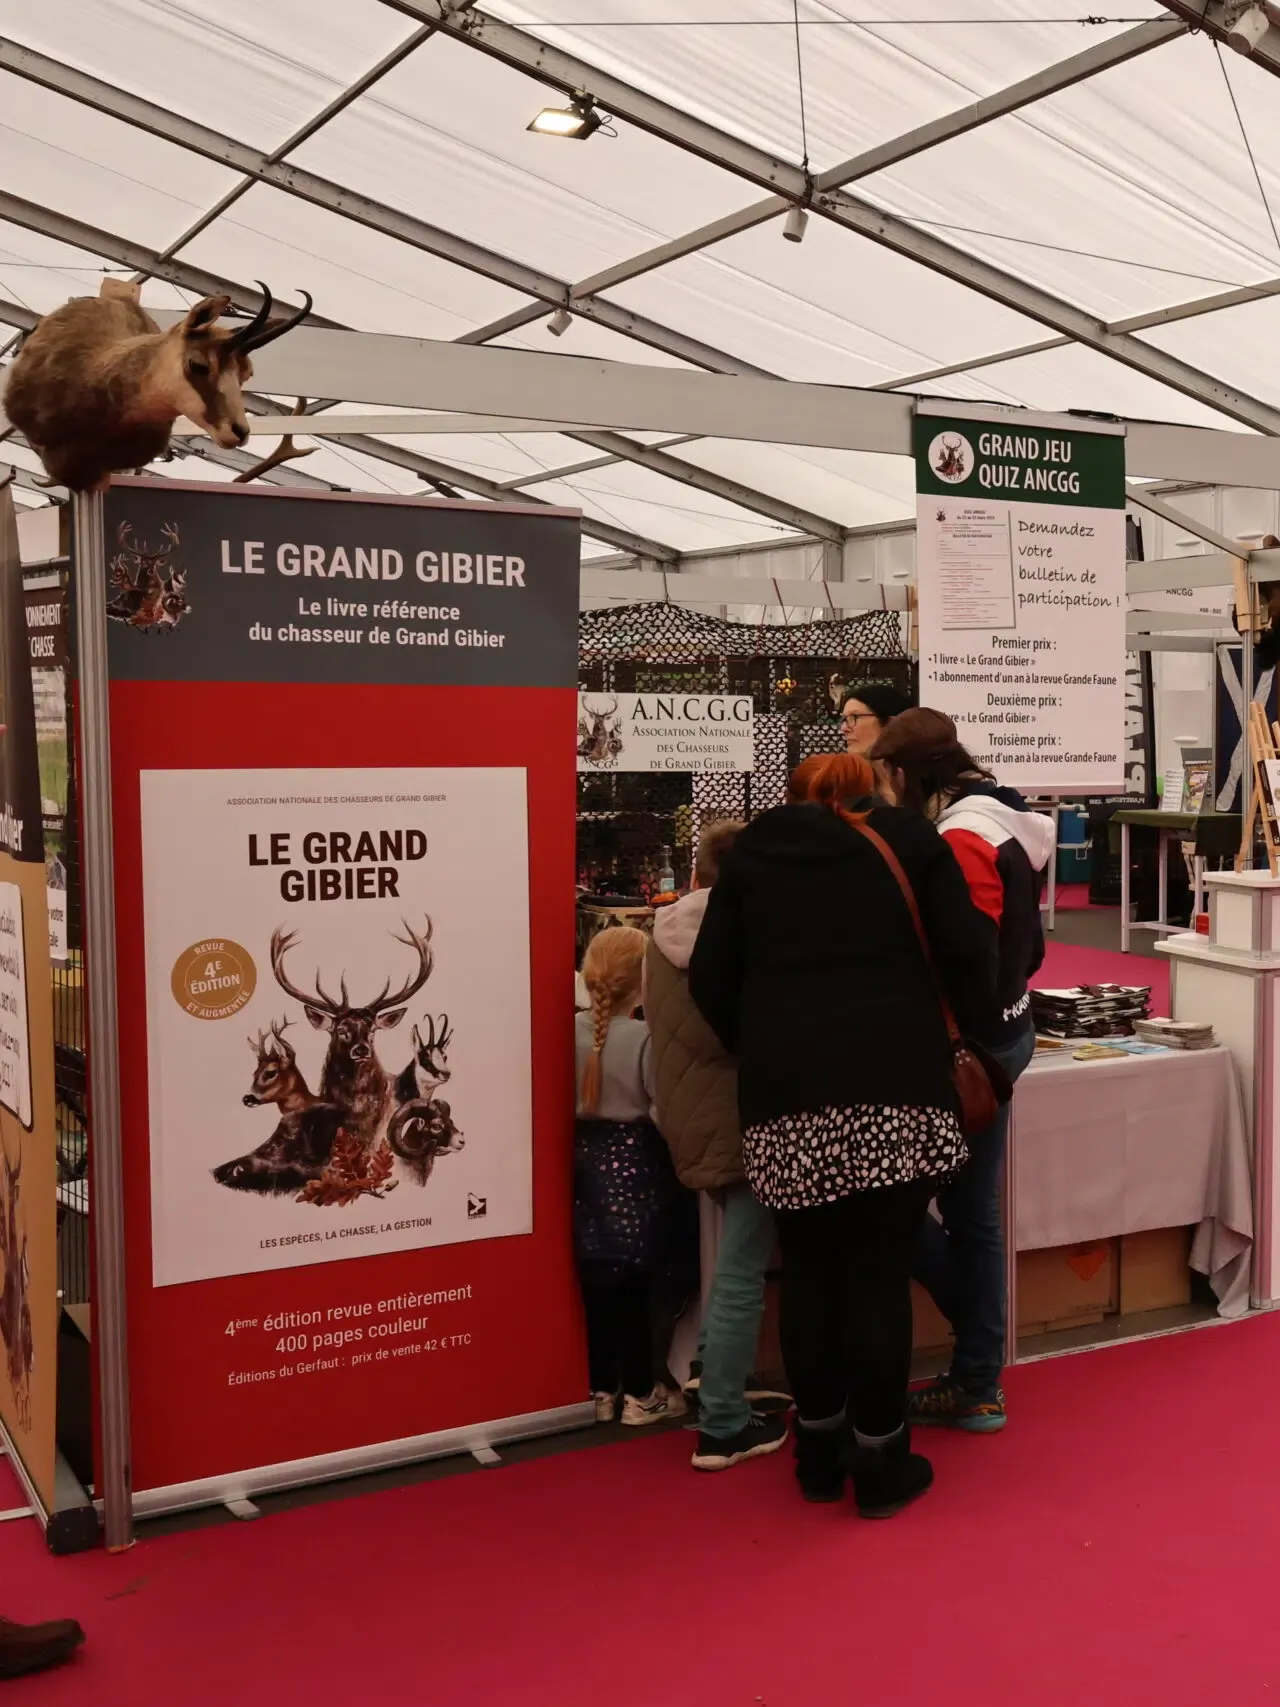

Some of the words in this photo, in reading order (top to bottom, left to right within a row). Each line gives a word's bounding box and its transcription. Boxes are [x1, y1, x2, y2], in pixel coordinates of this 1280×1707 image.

[979, 433, 1039, 460] GRAND
[1043, 439, 1072, 463] JEU
[979, 463, 1020, 489] QUIZ
[1024, 467, 1080, 494] ANCGG
[1018, 520, 1095, 537] Demandez
[1018, 545, 1053, 558] votre
[221, 539, 265, 575] LE
[276, 543, 404, 580] GRAND
[416, 550, 526, 587] GIBIER
[1019, 565, 1077, 582] bulletin
[1080, 569, 1097, 583] de
[299, 597, 321, 616] Le
[327, 598, 368, 618] livre
[373, 600, 461, 621] référence
[1018, 590, 1112, 611] participation
[249, 622, 272, 641] du
[278, 623, 363, 644] chasseur
[368, 626, 391, 644] de
[396, 627, 449, 647] Grand
[454, 629, 505, 648] Gibier
[992, 635, 1031, 649] Premier
[1033, 637, 1051, 651] prix
[31, 635, 56, 658] CHASSE
[939, 653, 958, 665] livre
[967, 655, 977, 665] Le
[978, 655, 1003, 666] Grand
[1005, 655, 1029, 667] Gibier
[939, 671, 993, 683] abonnement
[1014, 675, 1025, 684] an
[1032, 673, 1039, 684] la
[1041, 675, 1062, 685] revue
[1063, 674, 1091, 685] Grande
[1093, 674, 1117, 685] Faune
[632, 697, 750, 722] A.N.C.G.G
[987, 692, 1036, 707] Deuxième
[1038, 694, 1057, 709] prix
[968, 713, 977, 723] Le
[978, 712, 1003, 723] Grand
[1005, 712, 1030, 724] Gibier
[632, 725, 696, 737] ASSOCIATION
[699, 725, 751, 738] NATIONALE
[988, 732, 1036, 747] Troisième
[1038, 734, 1057, 748] prix
[656, 744, 674, 753] DES
[676, 741, 729, 753] CHASSEURS
[650, 760, 661, 769] DE
[665, 757, 701, 769] GRAND
[703, 757, 736, 769] GIBIER
[1014, 755, 1025, 763] an
[1032, 752, 1040, 763] la
[1041, 755, 1063, 763] revue
[1064, 752, 1092, 763] Grande
[1094, 752, 1117, 763] Faune
[227, 798, 277, 806] ASSOCIATION
[279, 797, 322, 805] NATIONALE
[324, 796, 338, 804] DES
[340, 795, 383, 804] CHASSEURS
[384, 795, 395, 803] DE
[396, 794, 421, 803] GRAND
[423, 794, 447, 802] GIBIER
[248, 833, 291, 867] LE
[303, 829, 428, 865] GRAND
[280, 866, 400, 903] GIBIER
[194, 942, 225, 955] REVUE
[190, 974, 241, 995] ÉDITION
[186, 1002, 199, 1013] ET
[260, 1239, 278, 1249] LES
[280, 1232, 323, 1247] ESPÈCES,
[325, 1230, 338, 1241] LA
[339, 1224, 379, 1238] CHASSE,
[380, 1223, 393, 1233] LA
[394, 1217, 432, 1231] GESTION
[225, 1317, 258, 1337] 4ème
[263, 1309, 322, 1332] édition
[327, 1302, 373, 1322] revue
[377, 1284, 472, 1313] entièrement
[275, 1334, 308, 1354] 400
[312, 1326, 363, 1351] pages
[368, 1314, 429, 1338] couleur
[228, 1368, 276, 1386] Éditions
[279, 1365, 294, 1377] du
[296, 1356, 339, 1375] Gerfaut
[351, 1350, 373, 1366] prix
[375, 1348, 389, 1360] de
[391, 1343, 421, 1357] vente
[424, 1339, 438, 1352] 42
[449, 1333, 472, 1347] TTC
